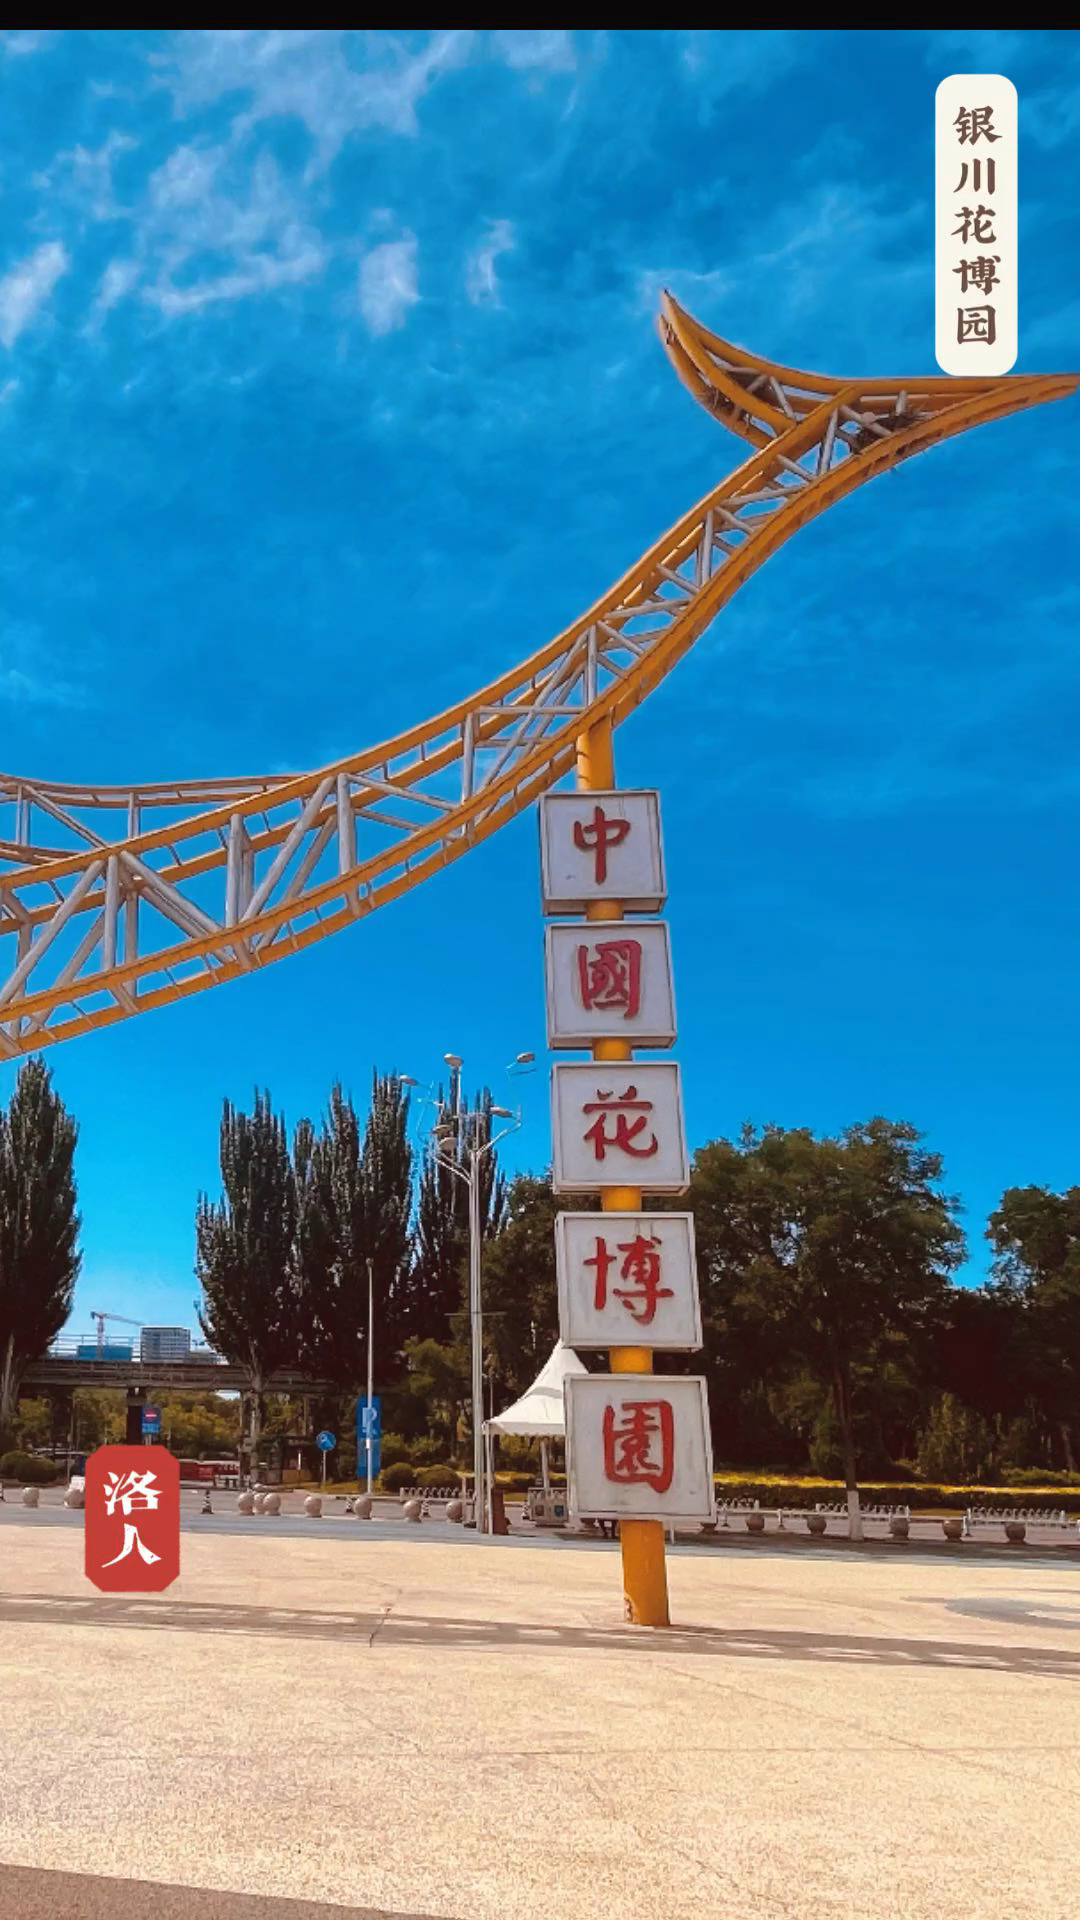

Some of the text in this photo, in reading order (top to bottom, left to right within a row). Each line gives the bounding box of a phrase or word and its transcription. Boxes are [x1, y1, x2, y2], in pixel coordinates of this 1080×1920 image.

[573, 806, 674, 1493] 中國花博園
